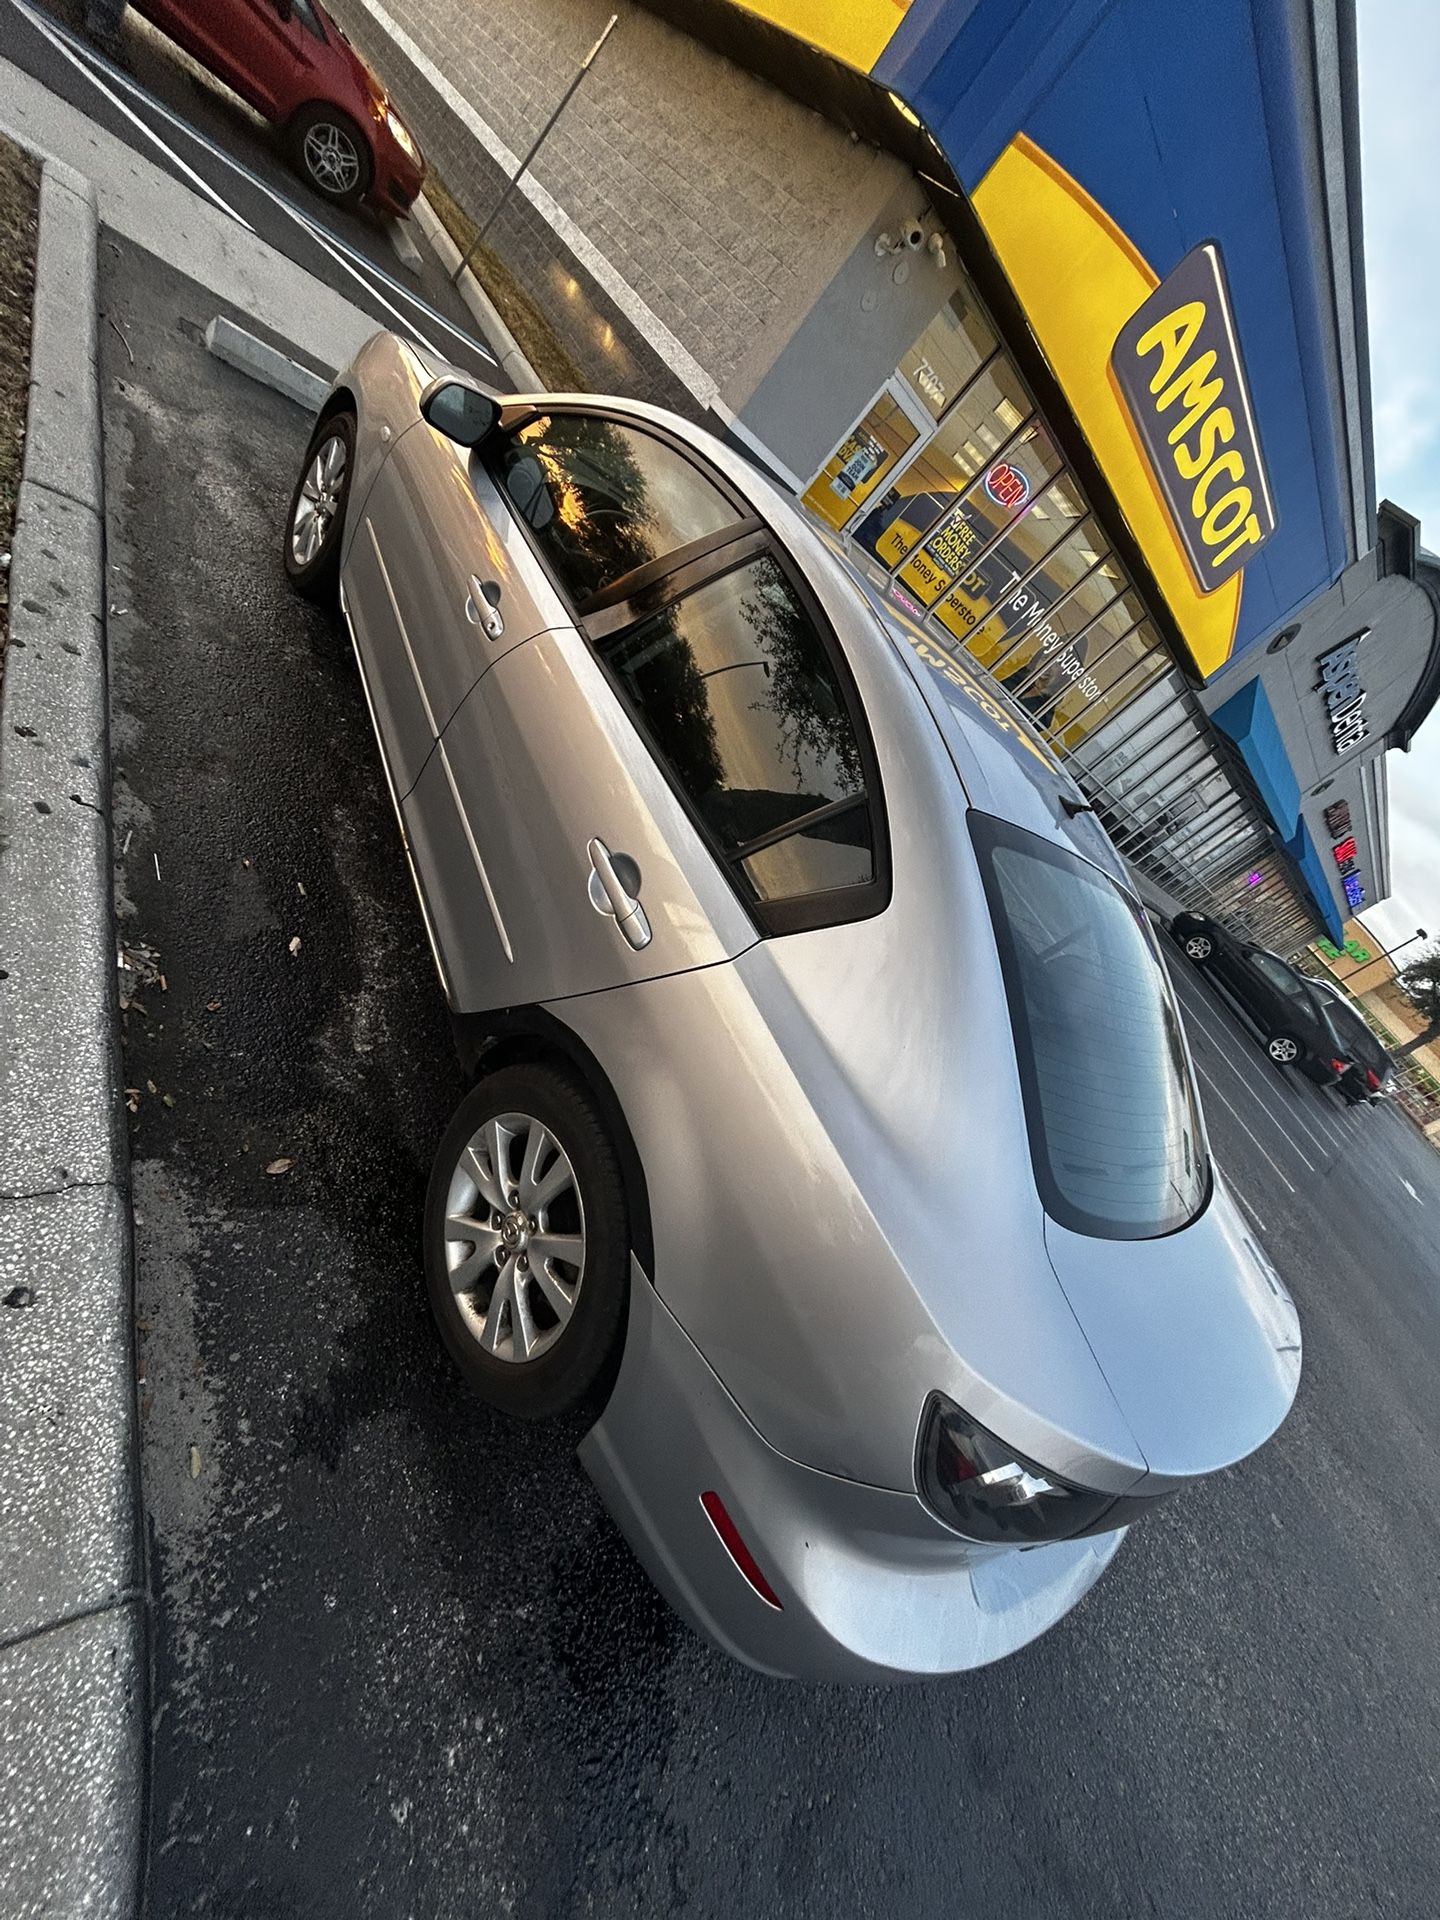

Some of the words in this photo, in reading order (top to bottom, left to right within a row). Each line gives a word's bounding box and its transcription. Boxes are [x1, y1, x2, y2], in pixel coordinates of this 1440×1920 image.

[1136, 302, 1260, 567] AMSCOT
[846, 466, 859, 481] TEAM
[989, 464, 1027, 508] OPEN
[929, 535, 963, 572] ORDERS
[939, 526, 971, 559] MONEY
[953, 521, 976, 546] FREE
[889, 533, 908, 556] The
[933, 579, 984, 634] Sperstoe
[1054, 645, 1102, 706] Supestor
[1315, 632, 1366, 710] Aspen
[1331, 692, 1371, 756] Dental
